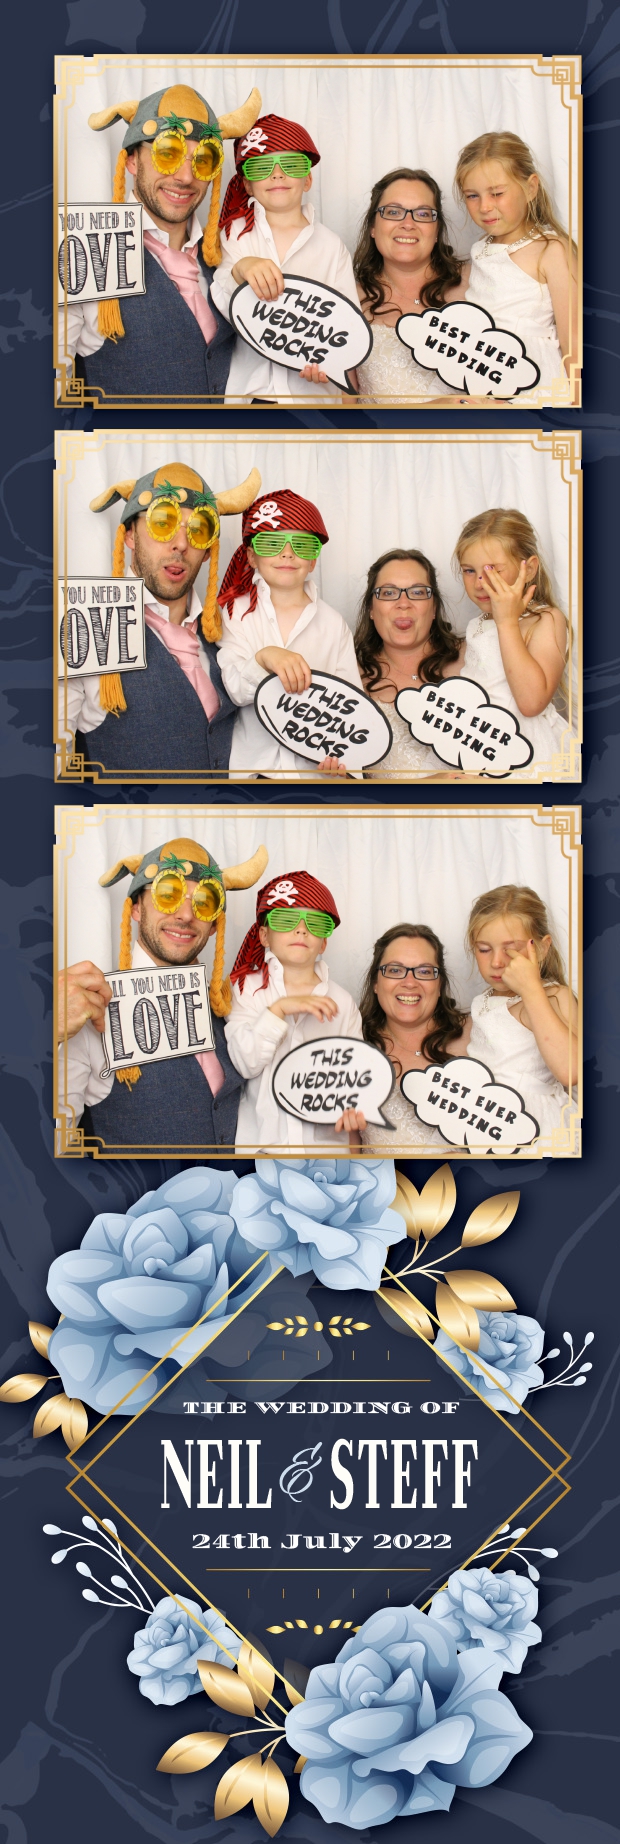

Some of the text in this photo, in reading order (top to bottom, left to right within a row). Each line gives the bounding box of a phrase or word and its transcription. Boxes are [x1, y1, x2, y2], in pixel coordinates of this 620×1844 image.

[59, 211, 136, 231] YOU NEED IS
[283, 287, 336, 318] THIS
[252, 301, 349, 347] WEDDING
[429, 316, 518, 369] BEST EVER
[259, 328, 329, 364] ROCKS
[424, 335, 503, 384] WEDDING
[61, 585, 137, 605] YOU NEED IS
[309, 682, 360, 715] THIS
[276, 693, 370, 744] WEDDING
[421, 710, 497, 761] WEDDING
[426, 691, 512, 746] BEST EVER
[281, 720, 349, 758] ROCKS
[107, 972, 201, 998] LL YOU NEED IS
[108, 990, 206, 1061] LOVE
[310, 1047, 354, 1066] THIS
[290, 1069, 372, 1089] WEDDING
[431, 1071, 517, 1124] BEST EVER
[301, 1093, 359, 1112] ROCKS
[427, 1091, 502, 1141] WEDDING
